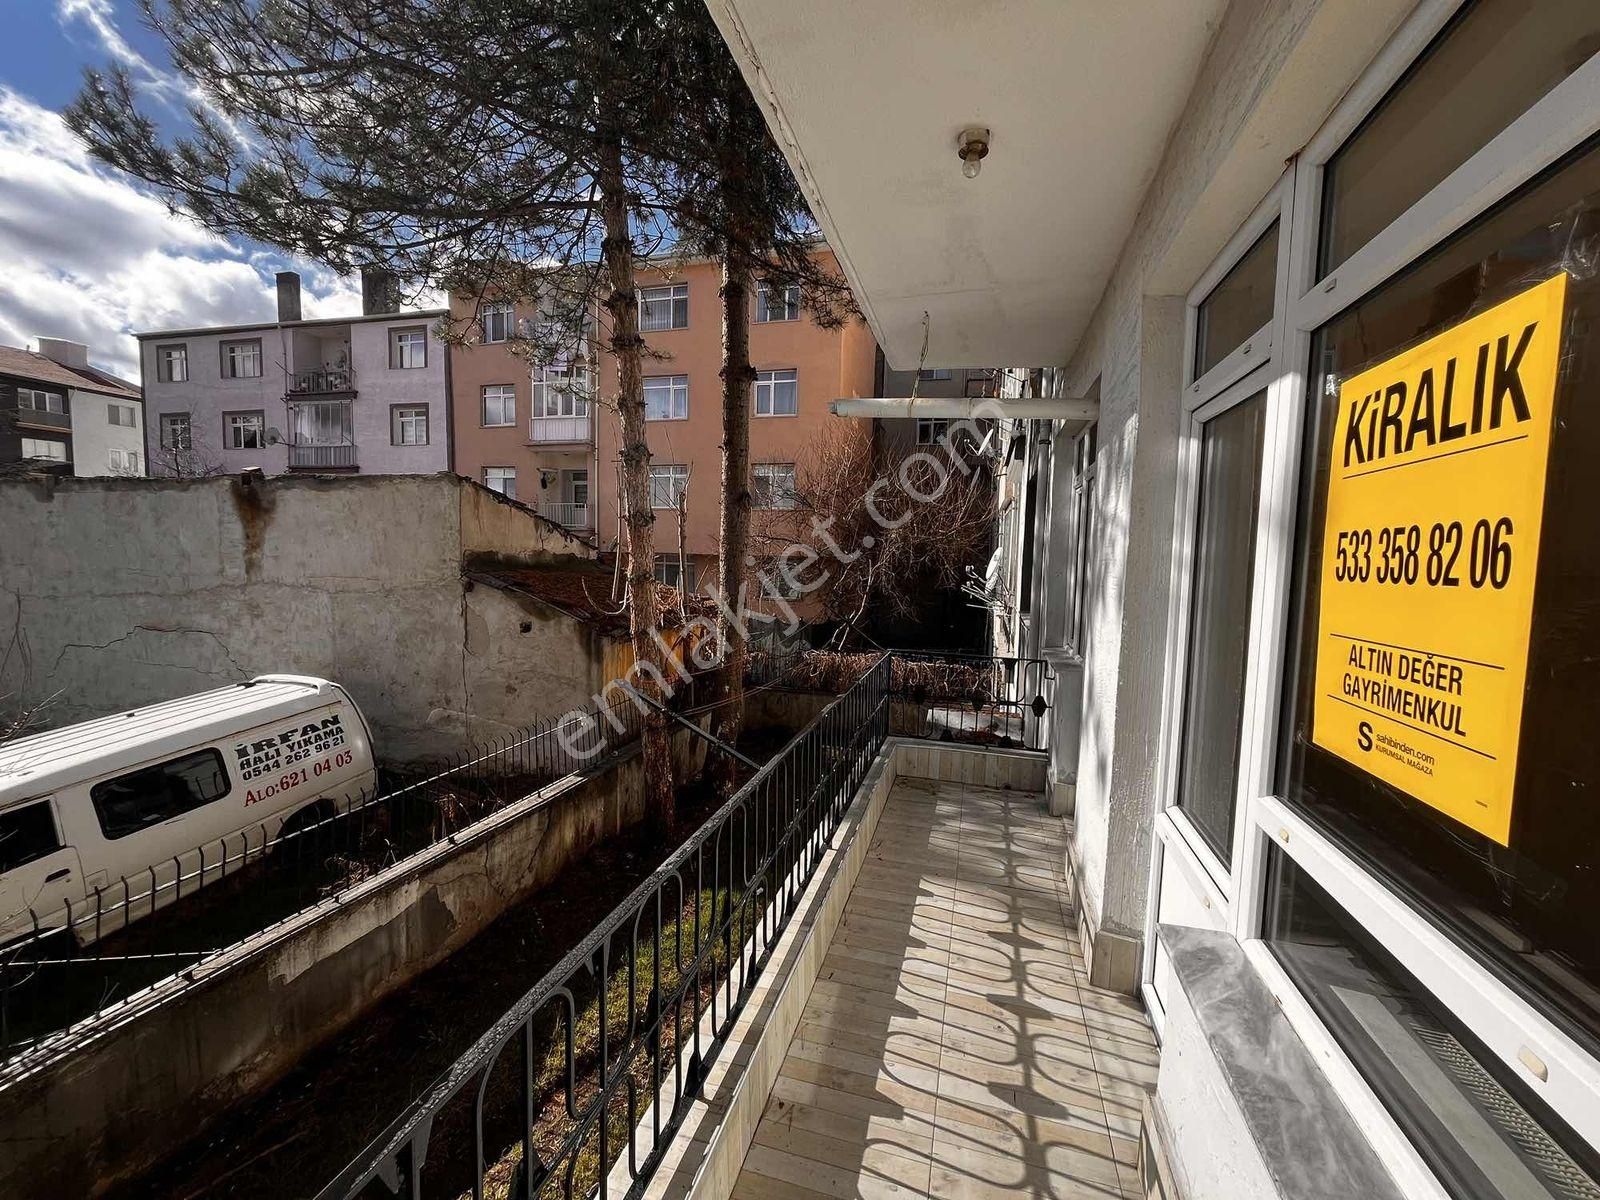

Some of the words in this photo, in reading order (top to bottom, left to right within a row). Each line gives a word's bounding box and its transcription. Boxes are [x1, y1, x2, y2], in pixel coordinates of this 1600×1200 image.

[1335, 529, 1372, 582] 533
[1376, 524, 1421, 585] 358
[1426, 521, 1463, 587] 82
[1469, 517, 1514, 590] 06
[1348, 644, 1393, 677] ALTIN
[1398, 653, 1463, 696] DEĞER
[1343, 672, 1467, 737] GAYRİMENKUL
[239, 747, 282, 770] HALI
[285, 726, 345, 753] YIKAMA
[242, 759, 281, 781] 0544
[285, 749, 311, 766] 262
[315, 740, 331, 754] 96
[333, 737, 345, 748] 21
[313, 758, 332, 777] 04
[335, 750, 353, 768] 03
[1375, 744, 1406, 764] KURUMSAL
[1406, 758, 1434, 776] MAĞAZA
[1376, 734, 1435, 766] sahibinden.com
